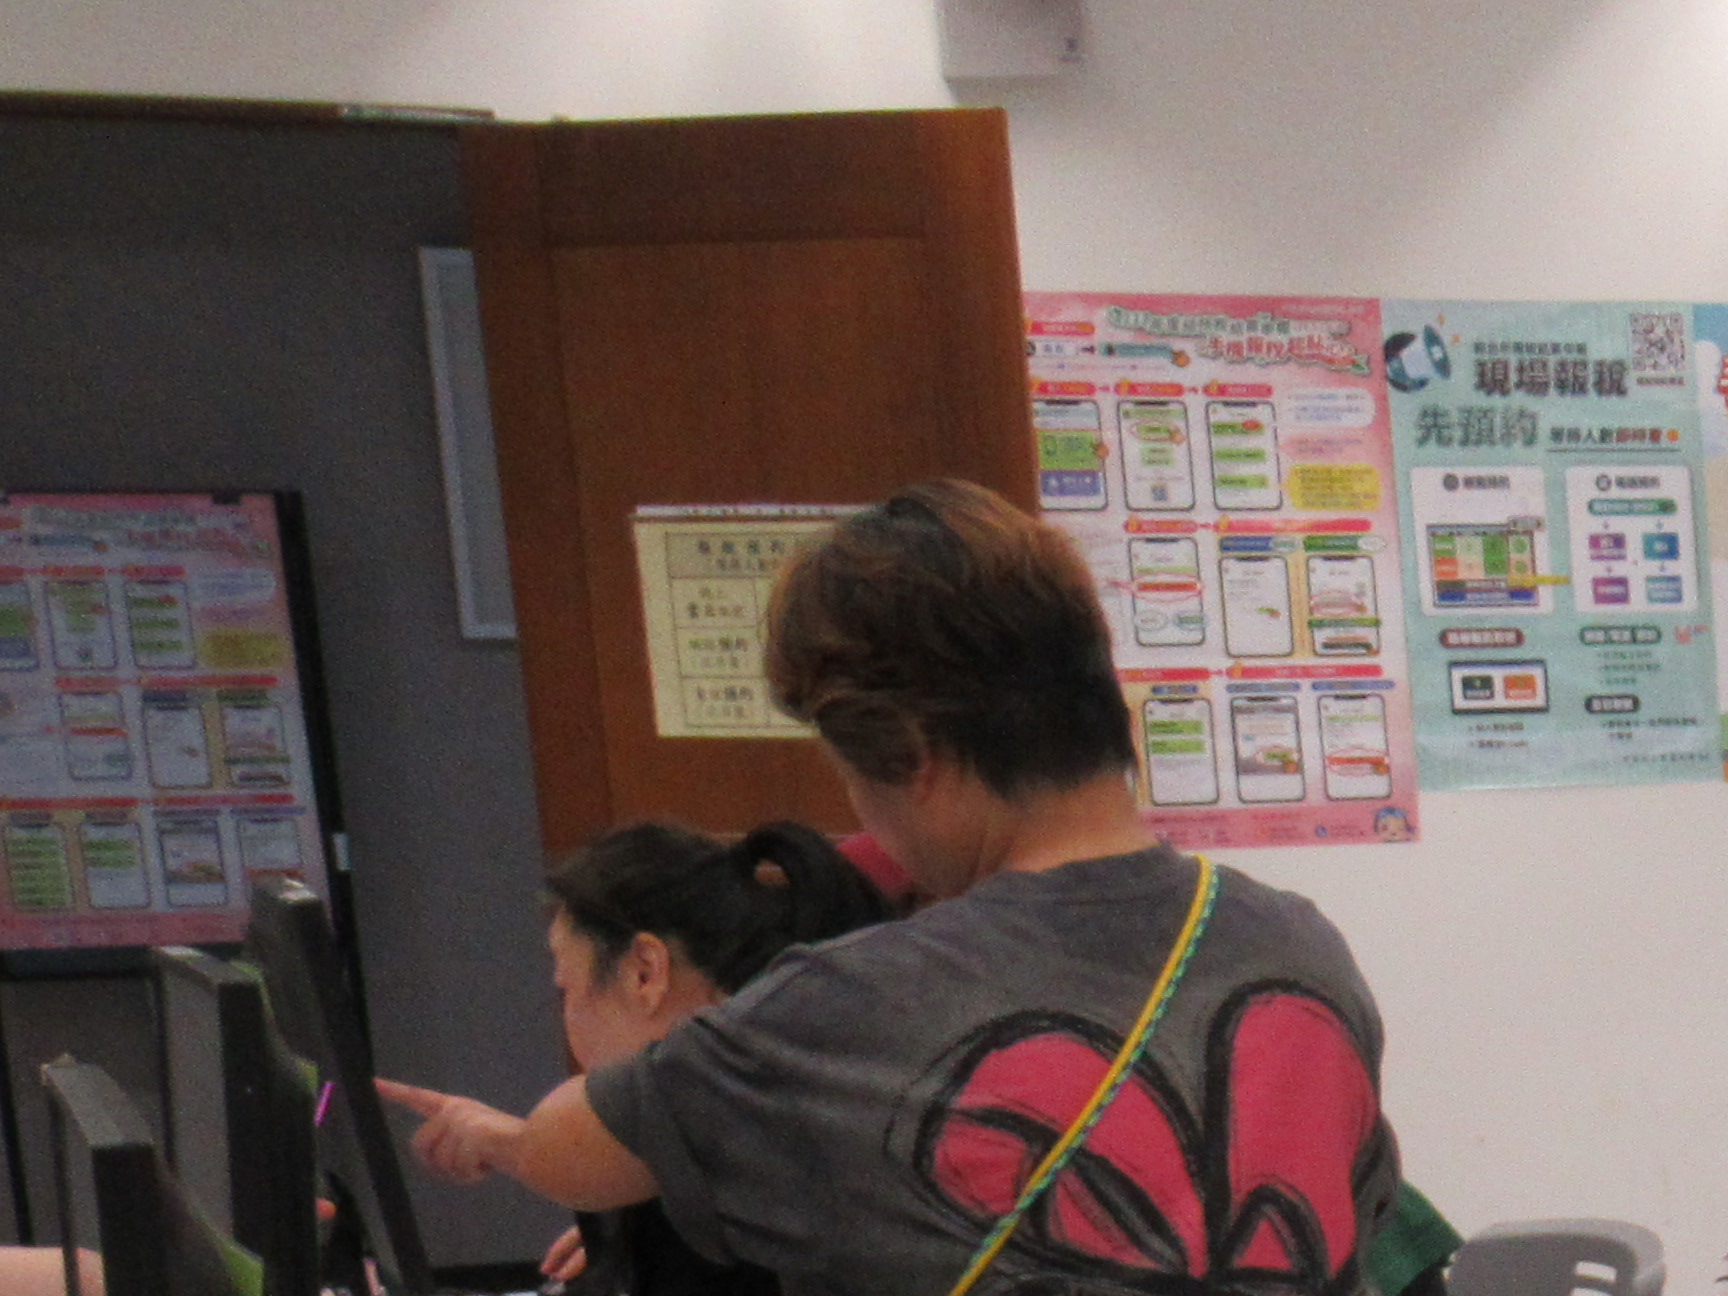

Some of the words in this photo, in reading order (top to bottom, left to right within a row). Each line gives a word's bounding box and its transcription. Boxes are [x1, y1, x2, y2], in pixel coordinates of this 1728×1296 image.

[1474, 357, 1629, 398] 現場報稅
[1414, 402, 1540, 447] 先預約
